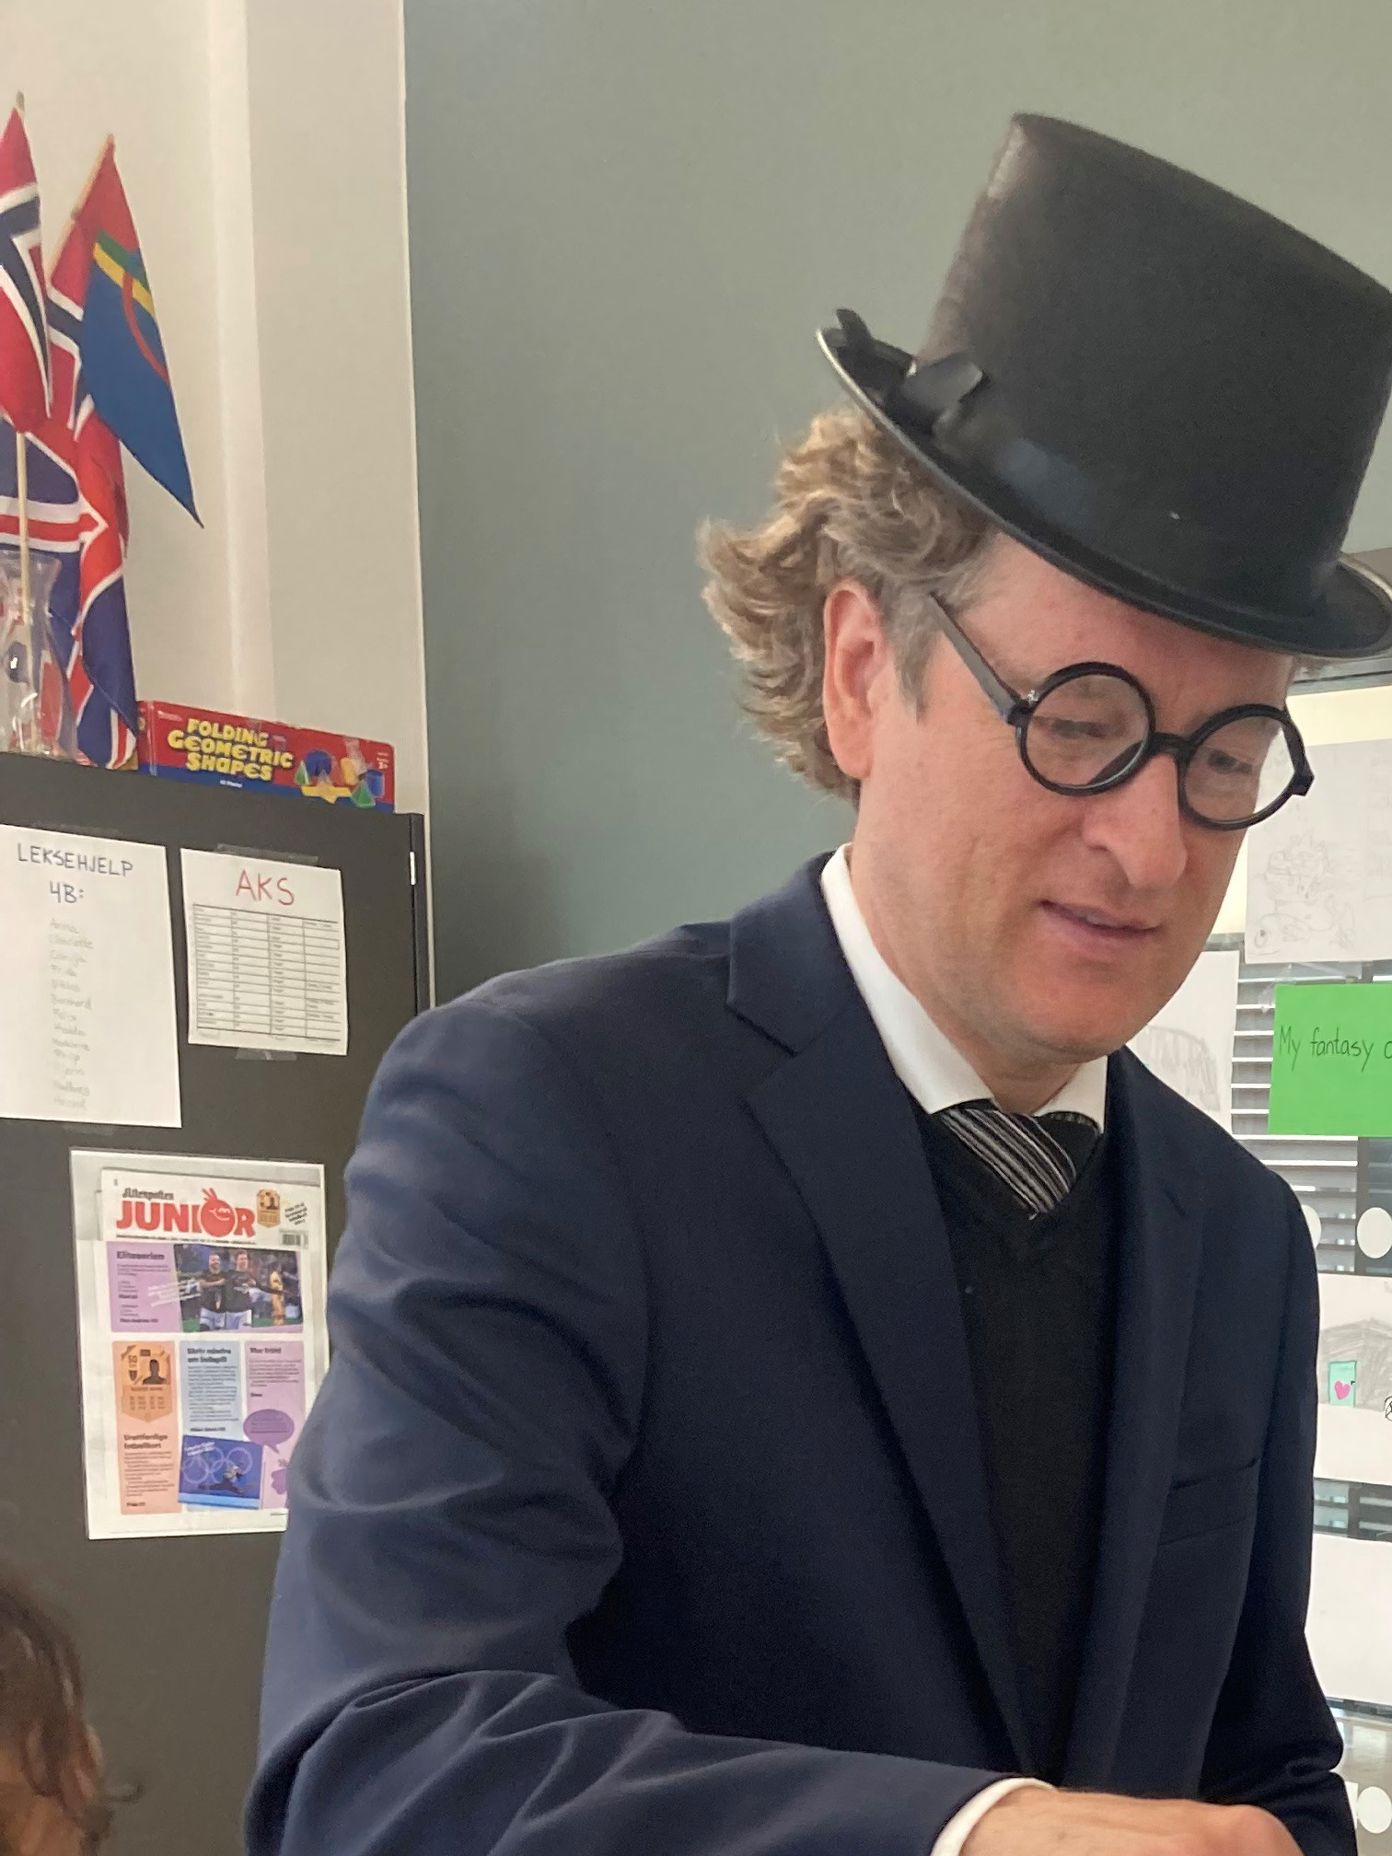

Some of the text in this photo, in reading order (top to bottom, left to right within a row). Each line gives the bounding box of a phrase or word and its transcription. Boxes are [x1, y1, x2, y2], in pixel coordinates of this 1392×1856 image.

[186, 717, 269, 749] FOLDING
[17, 843, 134, 878] LEKSEHJELP
[49, 881, 86, 904] 4B:
[235, 868, 295, 907] AKS
[1279, 1025, 1301, 1072] My
[1310, 1026, 1375, 1072] fantasy
[116, 1199, 256, 1238] JUNIOR
